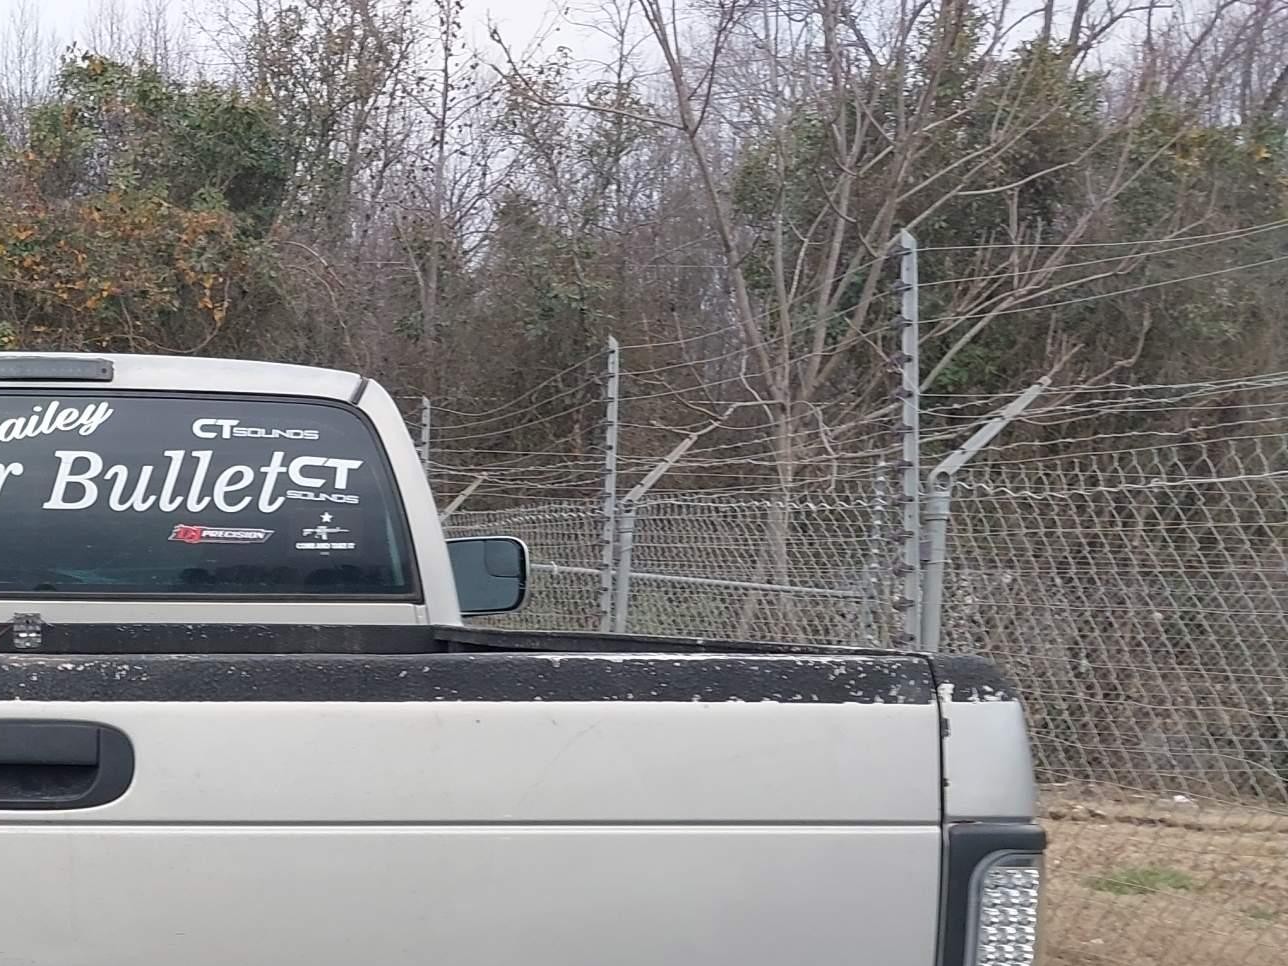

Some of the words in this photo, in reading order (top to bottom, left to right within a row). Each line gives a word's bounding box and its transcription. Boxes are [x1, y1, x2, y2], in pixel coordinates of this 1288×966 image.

[192, 418, 239, 440] CT
[232, 428, 320, 440] SOUNDS
[42, 449, 287, 514] Bullet
[286, 455, 363, 490] CT
[285, 490, 360, 505] SOUNDS
[201, 529, 266, 541] PRECISION
